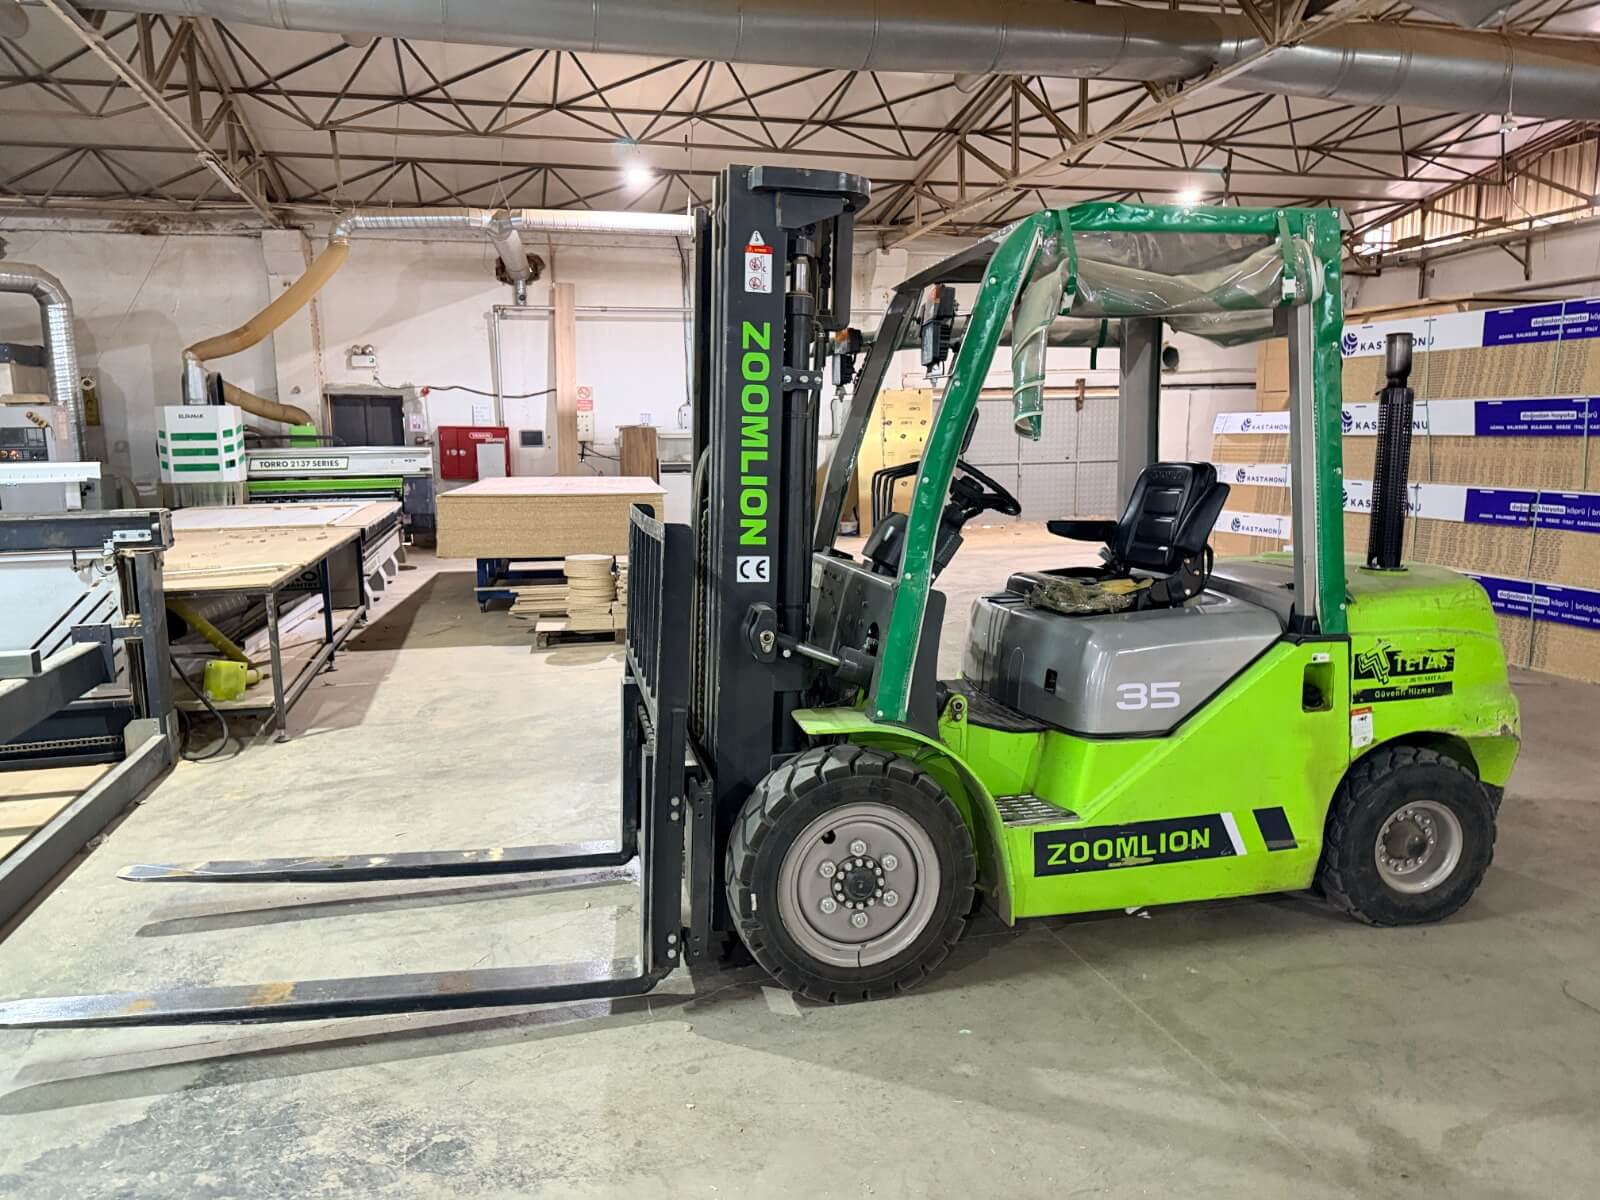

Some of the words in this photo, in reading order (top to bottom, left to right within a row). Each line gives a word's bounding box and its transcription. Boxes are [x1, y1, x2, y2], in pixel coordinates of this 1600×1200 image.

[1252, 423, 1288, 431] KASTAMON
[1355, 420, 1429, 431] KASNU
[741, 321, 770, 545] ZOOMLION
[1247, 475, 1287, 483] KASTAMONU
[1350, 498, 1421, 512] KASNU
[1241, 525, 1281, 535] KASTAMONU
[740, 559, 767, 580] CE
[1116, 681, 1180, 710] 35
[1047, 827, 1210, 866] ZOOMLION
